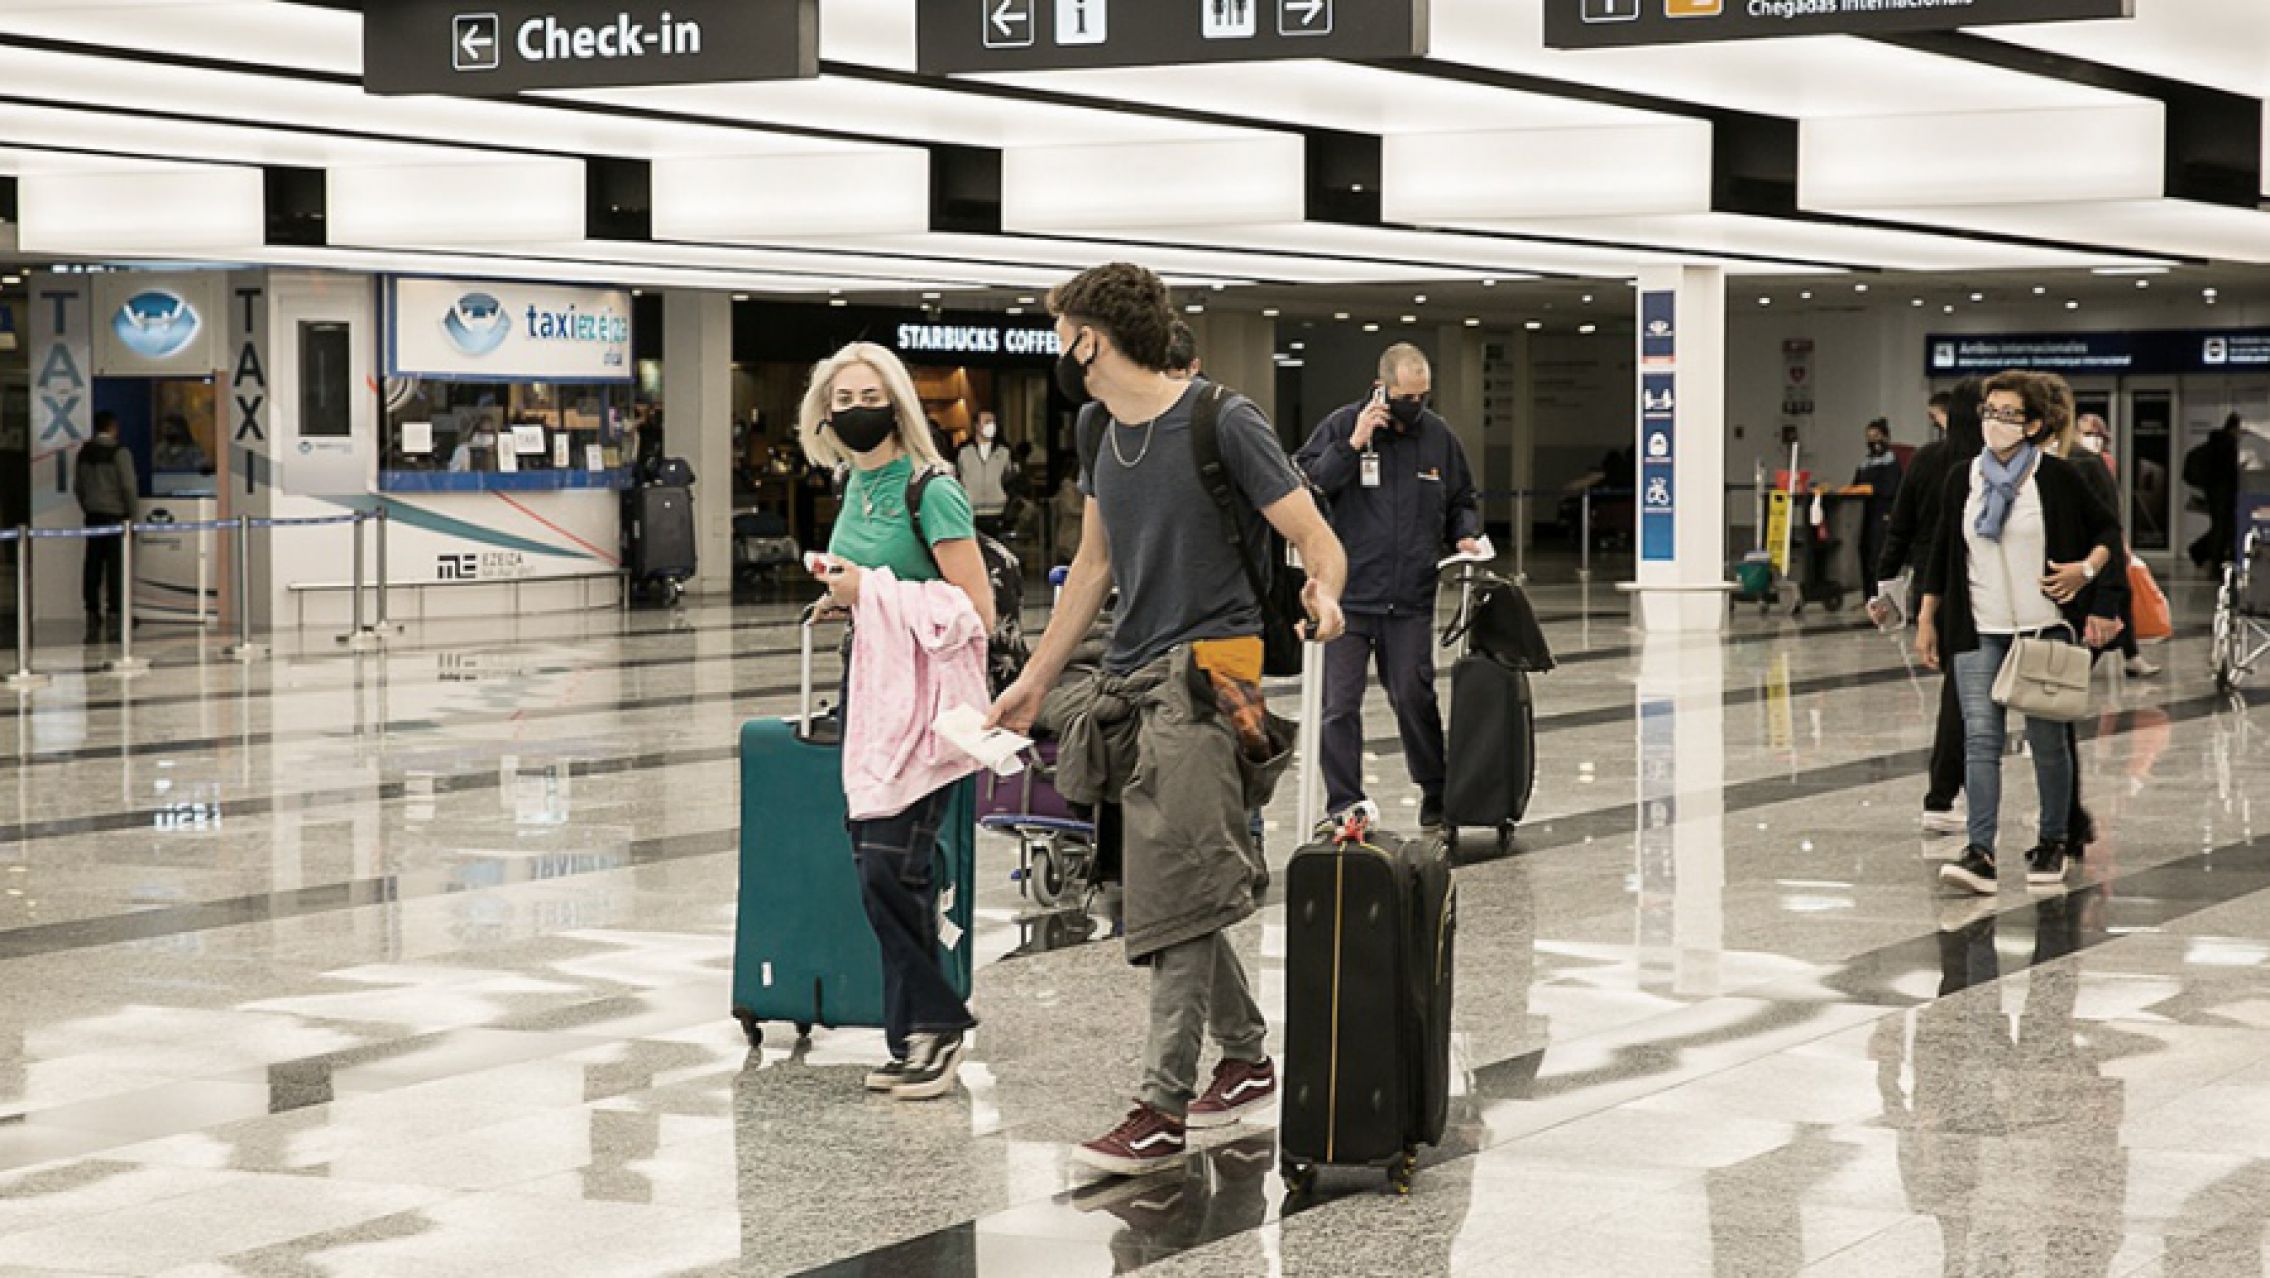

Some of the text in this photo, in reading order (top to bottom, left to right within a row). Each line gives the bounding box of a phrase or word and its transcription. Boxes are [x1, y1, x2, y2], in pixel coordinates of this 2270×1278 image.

[1748, 0, 1836, 18] Chegadas
[517, 12, 701, 61] Check-in
[897, 324, 1061, 354] STARBUCKS COFFE
[39, 289, 83, 494] TAXI
[234, 287, 265, 494] TAXI
